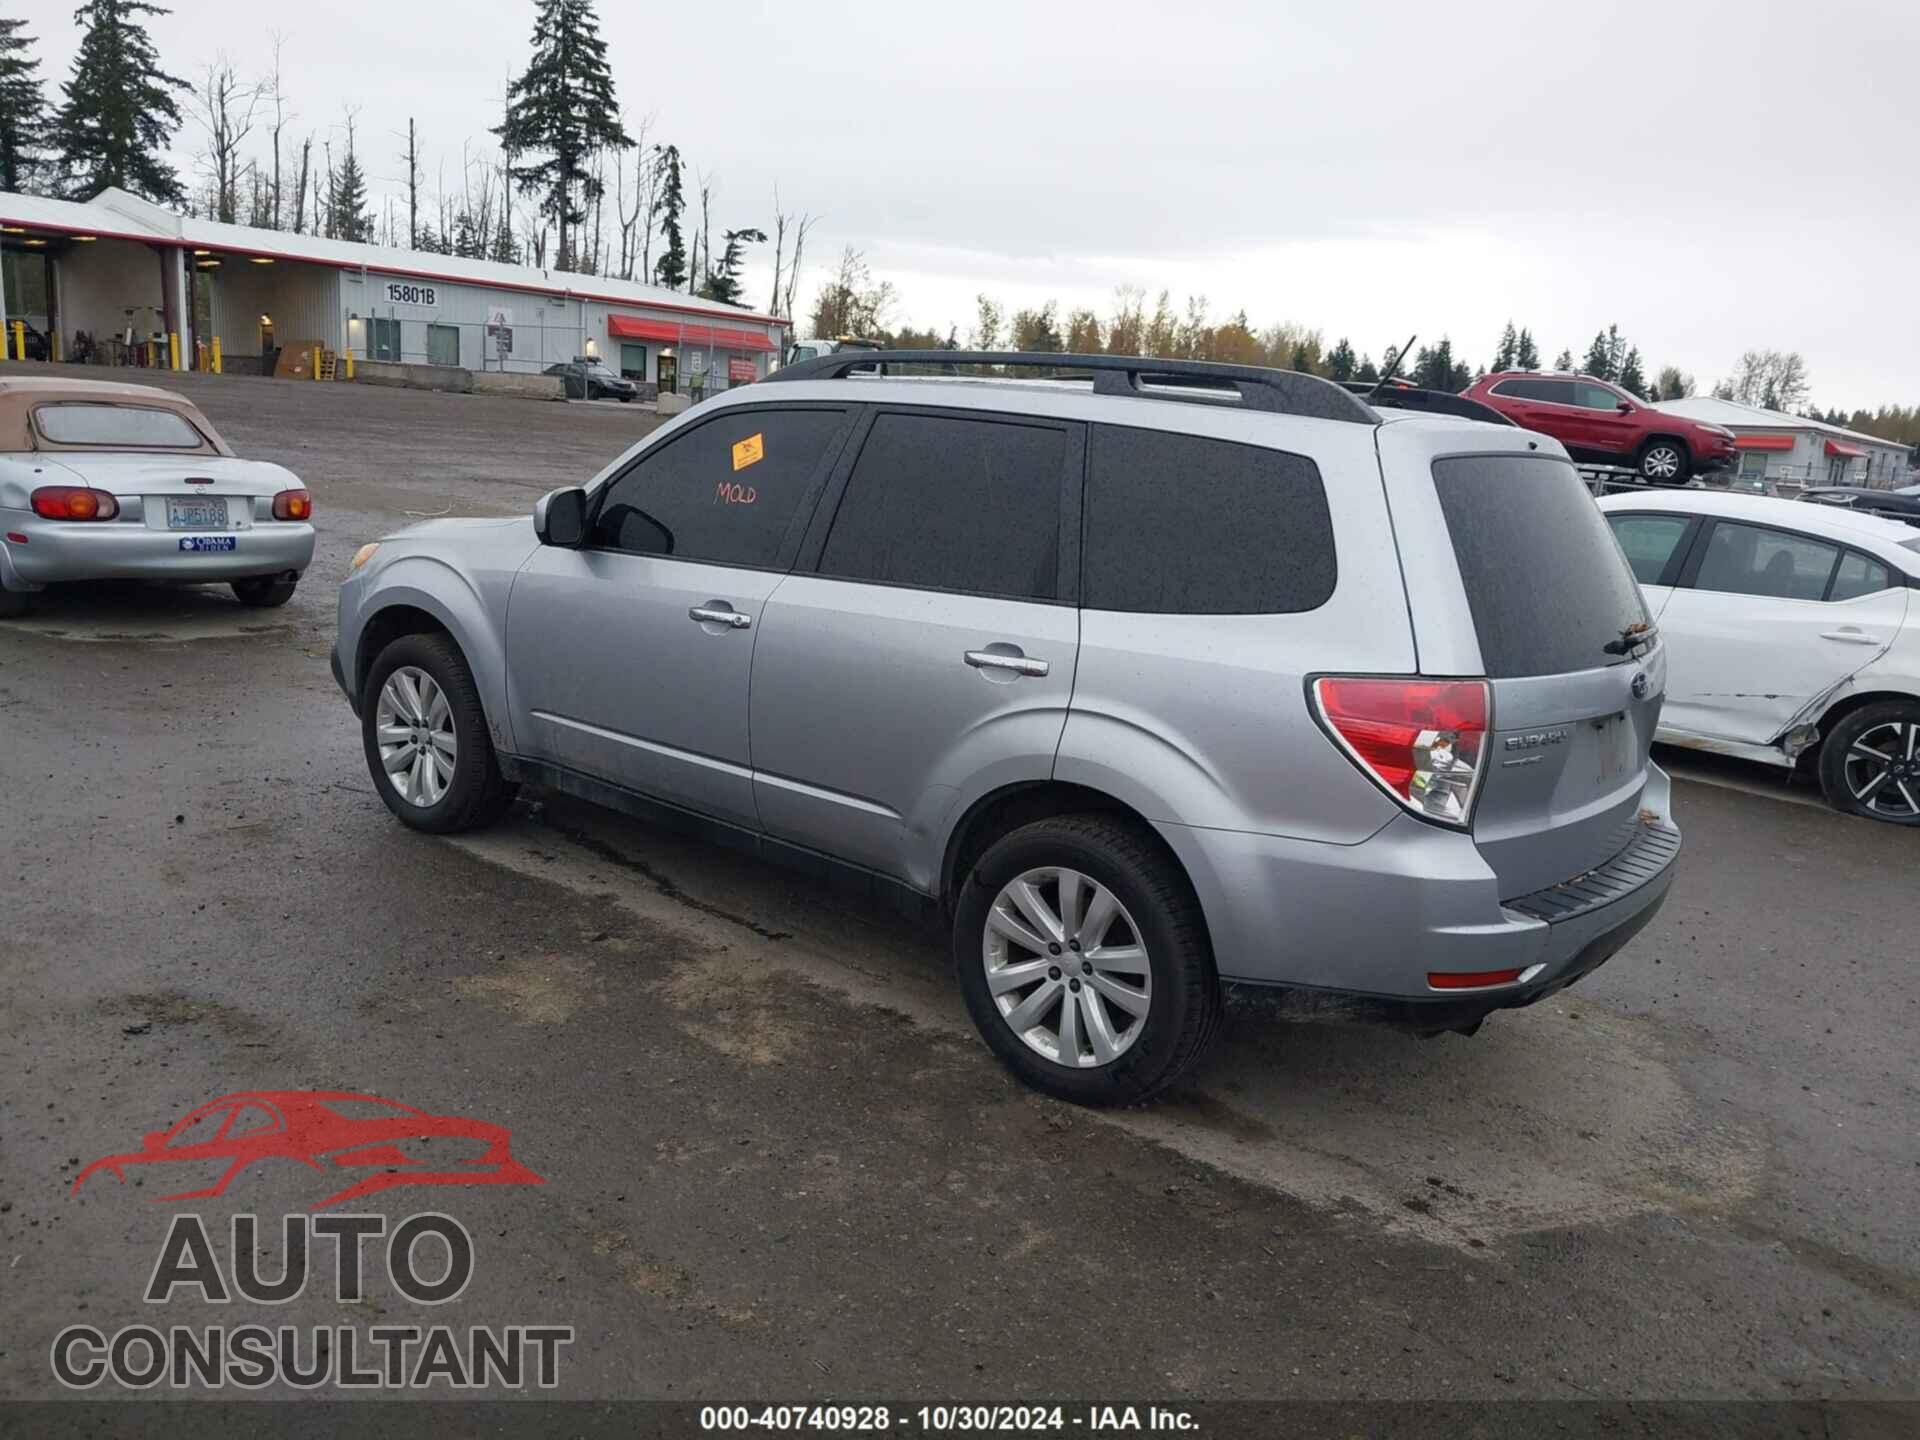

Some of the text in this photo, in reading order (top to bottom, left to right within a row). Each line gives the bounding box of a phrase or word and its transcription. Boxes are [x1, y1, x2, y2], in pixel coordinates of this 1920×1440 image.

[387, 284, 435, 305] 15801B
[713, 482, 757, 504] MOLD
[196, 537, 231, 545] OBAMA
